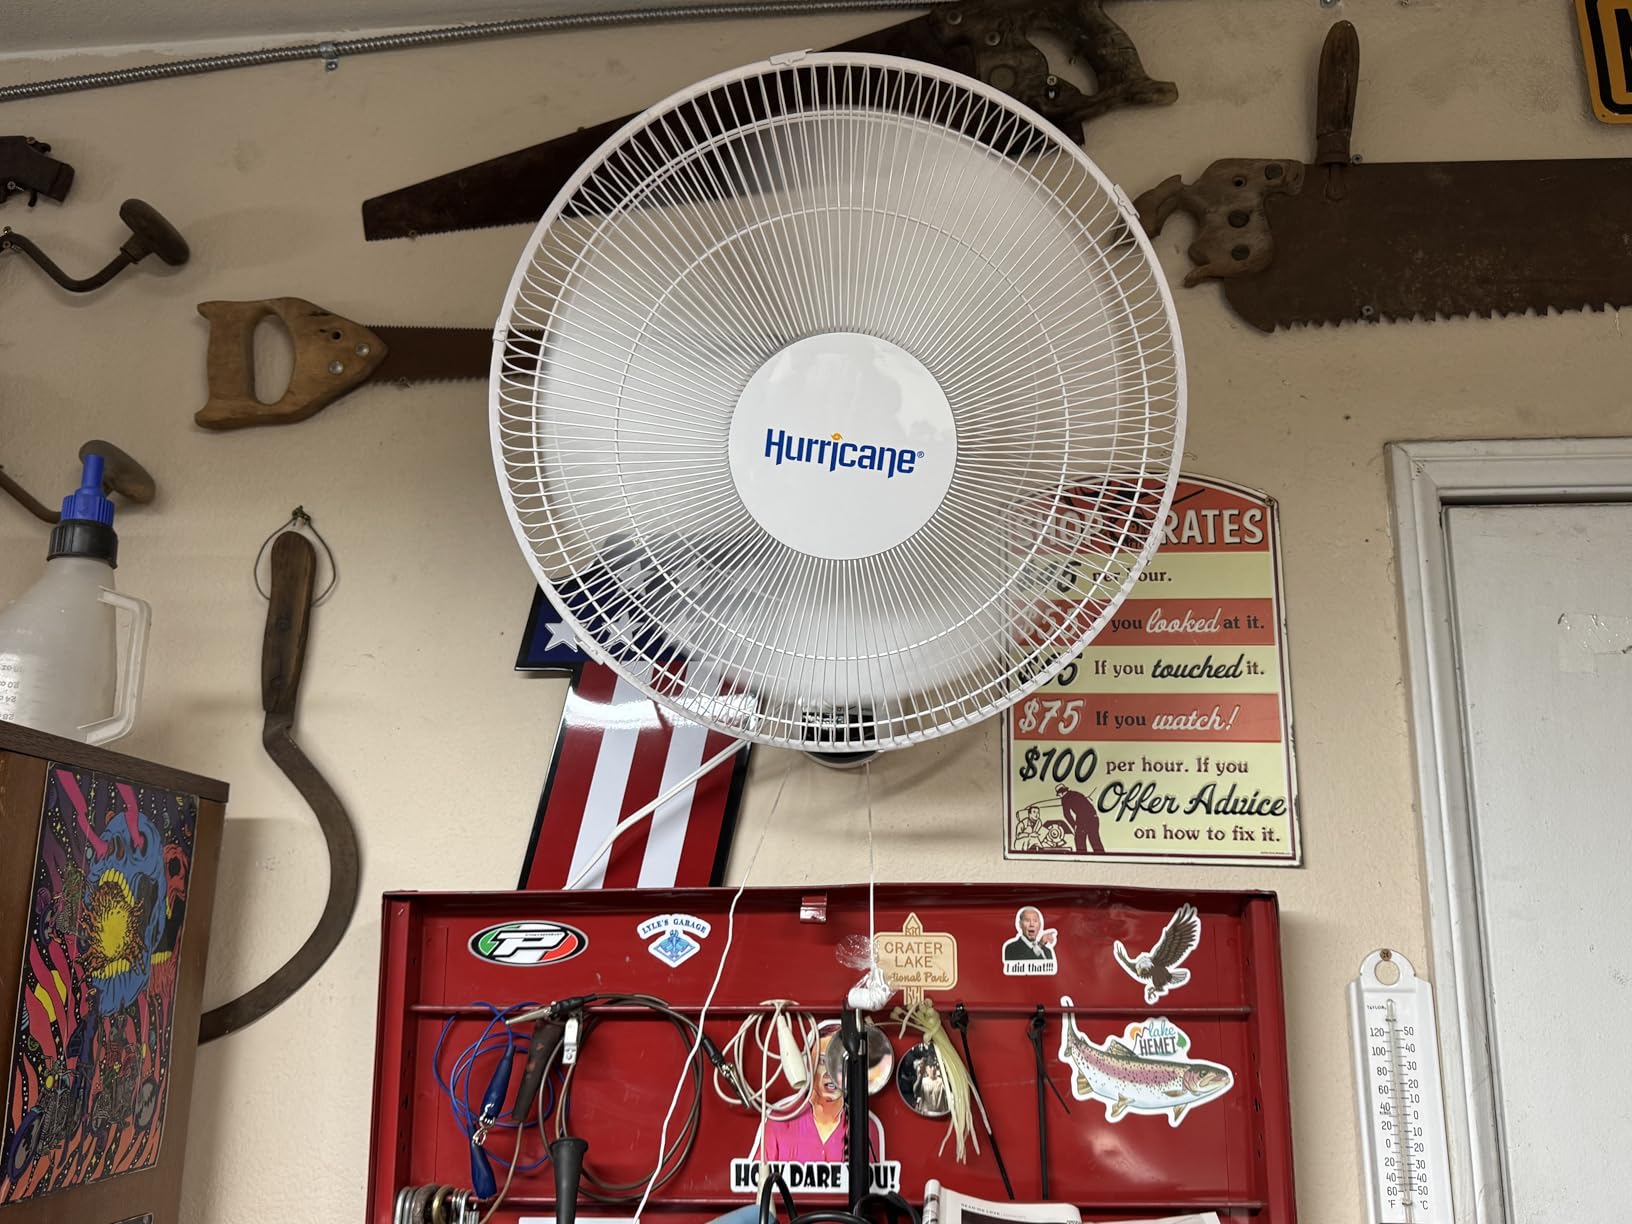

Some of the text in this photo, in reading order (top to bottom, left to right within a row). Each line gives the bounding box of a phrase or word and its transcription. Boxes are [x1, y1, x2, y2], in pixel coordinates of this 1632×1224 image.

[764, 428, 917, 479] Hurricane
[1160, 507, 1264, 545] RATES
[1126, 566, 1172, 582] our.
[1111, 618, 1143, 633] you
[1145, 607, 1221, 634] looked
[1223, 615, 1240, 629] at
[1247, 614, 1265, 629] it.
[1094, 660, 1107, 675] If
[1113, 663, 1144, 679] you
[1151, 653, 1245, 680] touched
[1247, 660, 1265, 675] it.
[1018, 698, 1241, 735] $75 If you watch!
[1019, 745, 1248, 783] $100 per hour. If you
[1097, 781, 1287, 822] Offer Advice
[1134, 825, 1280, 842] on how to fix it.
[641, 918, 707, 935] LYLE'S GARAGE
[884, 941, 943, 954] CRATER
[895, 955, 933, 968] LAKE
[1012, 961, 1025, 973] did
[1028, 962, 1054, 973] that!!!
[886, 971, 949, 983] tional Park
[1149, 1019, 1176, 1038] lake
[1370, 1027, 1385, 1037] 120
[1403, 1026, 1414, 1036] 50
[1139, 1036, 1176, 1056] HEMET
[1372, 1046, 1386, 1056] 100
[1405, 1043, 1416, 1053] 40
[1376, 1066, 1388, 1076] 80
[1406, 1061, 1417, 1071] 30
[1408, 1079, 1419, 1088] 20
[1378, 1085, 1389, 1095] 60
[1410, 1094, 1420, 1104] 10
[1380, 1102, 1391, 1111] 40
[1413, 1110, 1419, 1120] 0
[1381, 1121, 1392, 1130] 20
[1413, 1127, 1423, 1137] 10
[1385, 1138, 1391, 1148] 0
[1414, 1143, 1424, 1152] 20
[1384, 1157, 1395, 1166] 20
[1415, 1160, 1426, 1169] 30
[789, 1163, 842, 1188] DARE
[845, 1163, 897, 1189] U!
[1386, 1173, 1397, 1182] 40
[1416, 1173, 1427, 1182] 40
[1387, 1186, 1398, 1196] 60
[1417, 1186, 1428, 1196] 50
